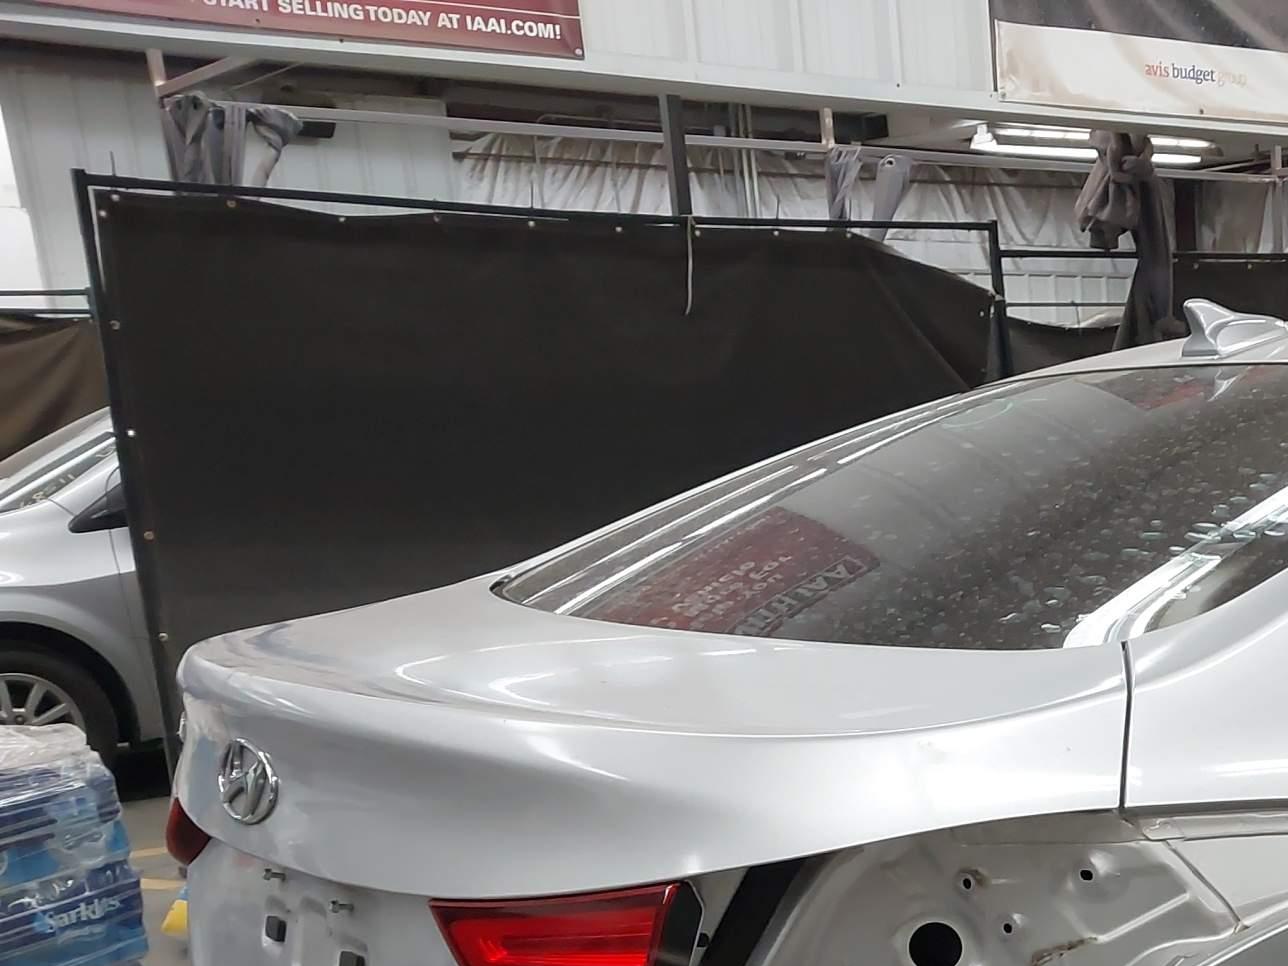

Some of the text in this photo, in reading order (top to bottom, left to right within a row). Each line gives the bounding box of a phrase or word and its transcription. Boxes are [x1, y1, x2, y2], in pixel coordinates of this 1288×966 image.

[278, 0, 364, 21] SELLING
[366, 5, 432, 26] TODAY
[437, 12, 460, 29] AT
[466, 15, 561, 39] IAAI.COM!
[1144, 61, 1170, 78] avis
[1171, 63, 1216, 85] budget
